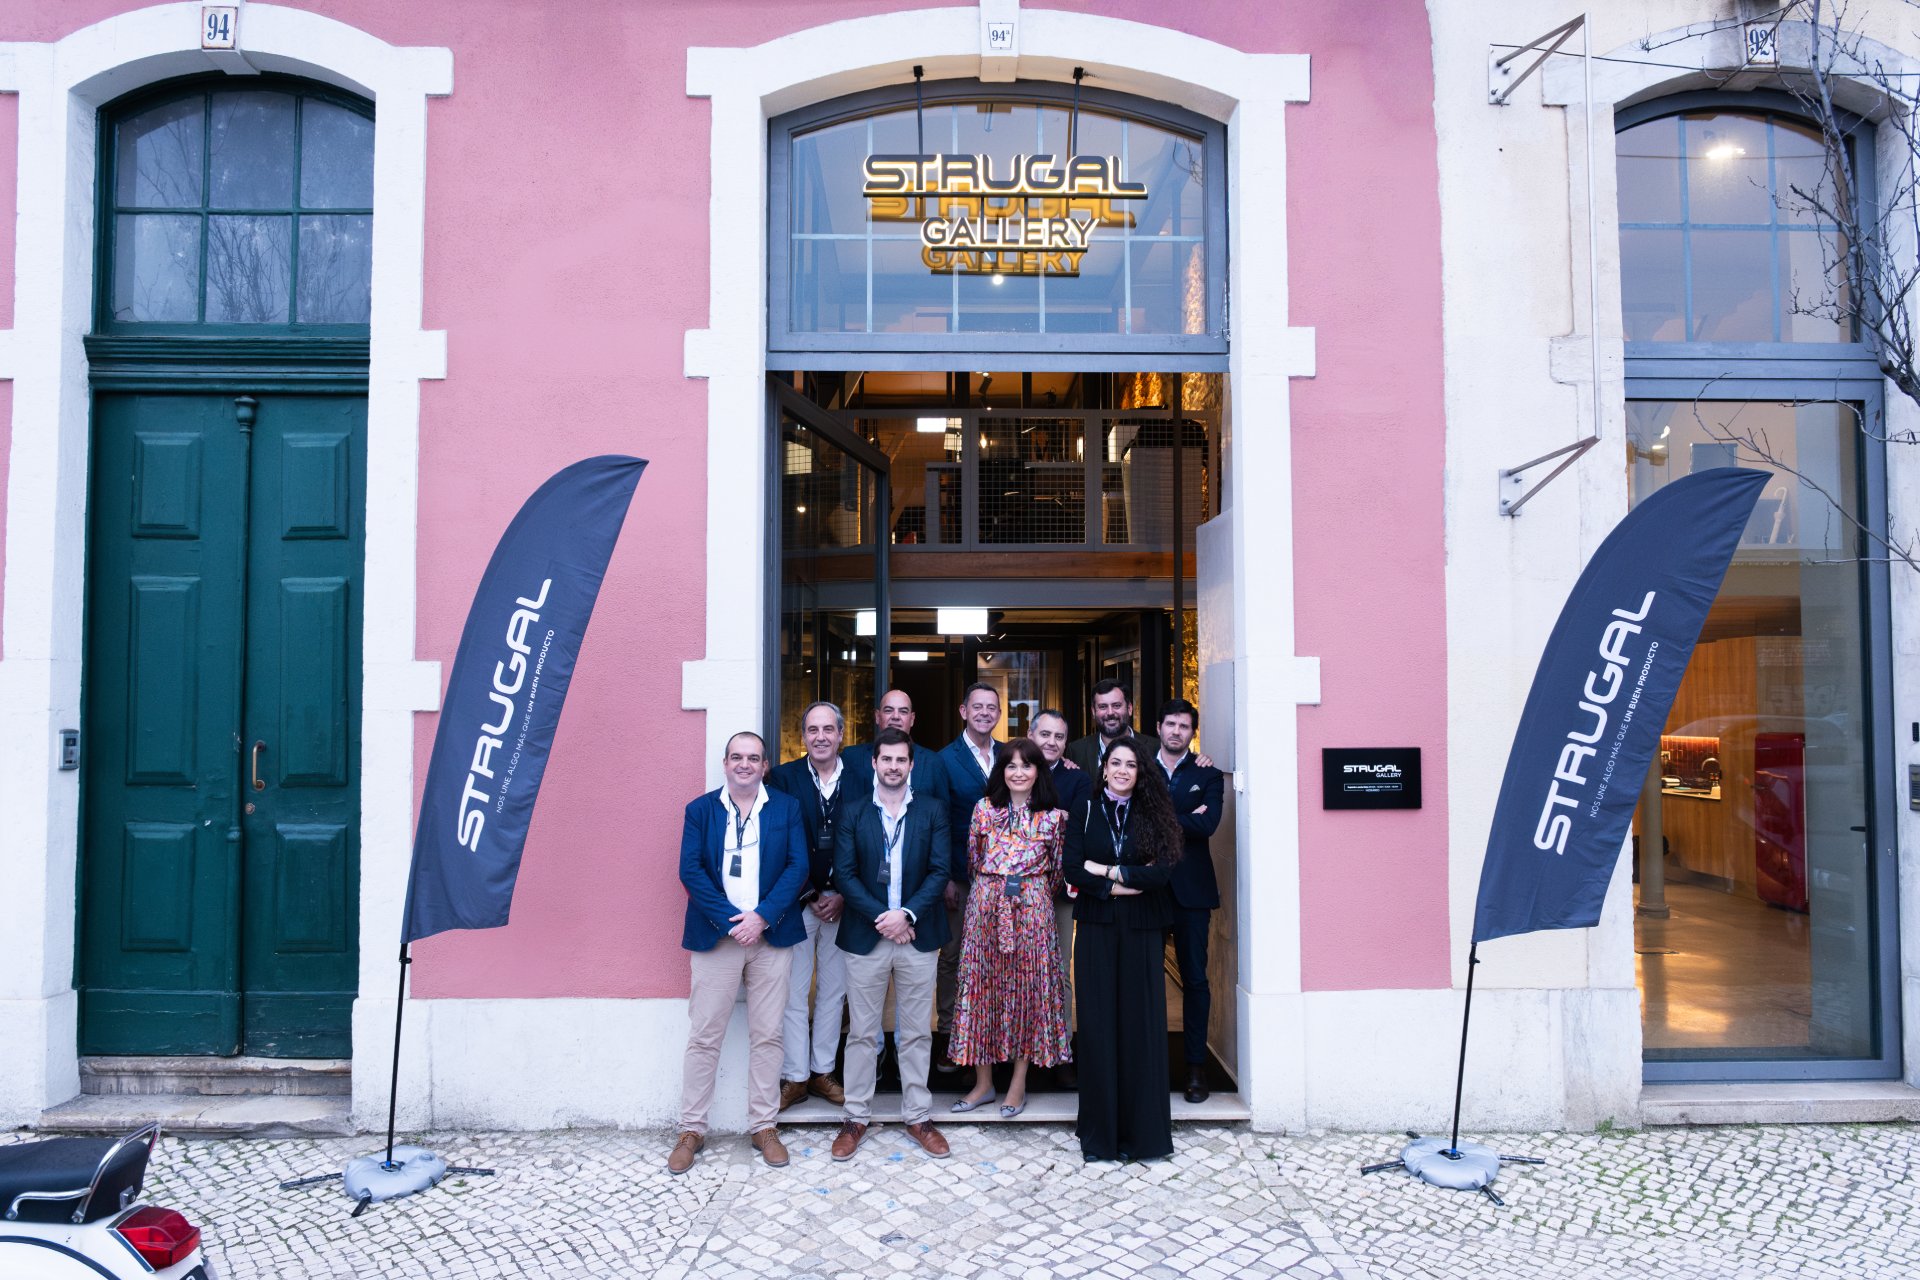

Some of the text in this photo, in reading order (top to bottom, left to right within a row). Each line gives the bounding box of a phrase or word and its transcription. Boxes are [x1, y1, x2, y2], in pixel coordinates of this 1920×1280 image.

[207, 13, 230, 41] 94
[863, 153, 1148, 194] STRUGAL
[921, 216, 1099, 248] GALLERY
[457, 578, 552, 852] STRUGAL
[496, 629, 555, 814] NOS UNE ALGO MÁS QUE UN BUEN PRODUCTO
[1343, 765, 1402, 773] STRUGAL
[1533, 591, 1656, 856] STRUGAL
[1589, 641, 1659, 818] NOS UNE ALGO MÁS QUE UN BUEN PRODUCTO
